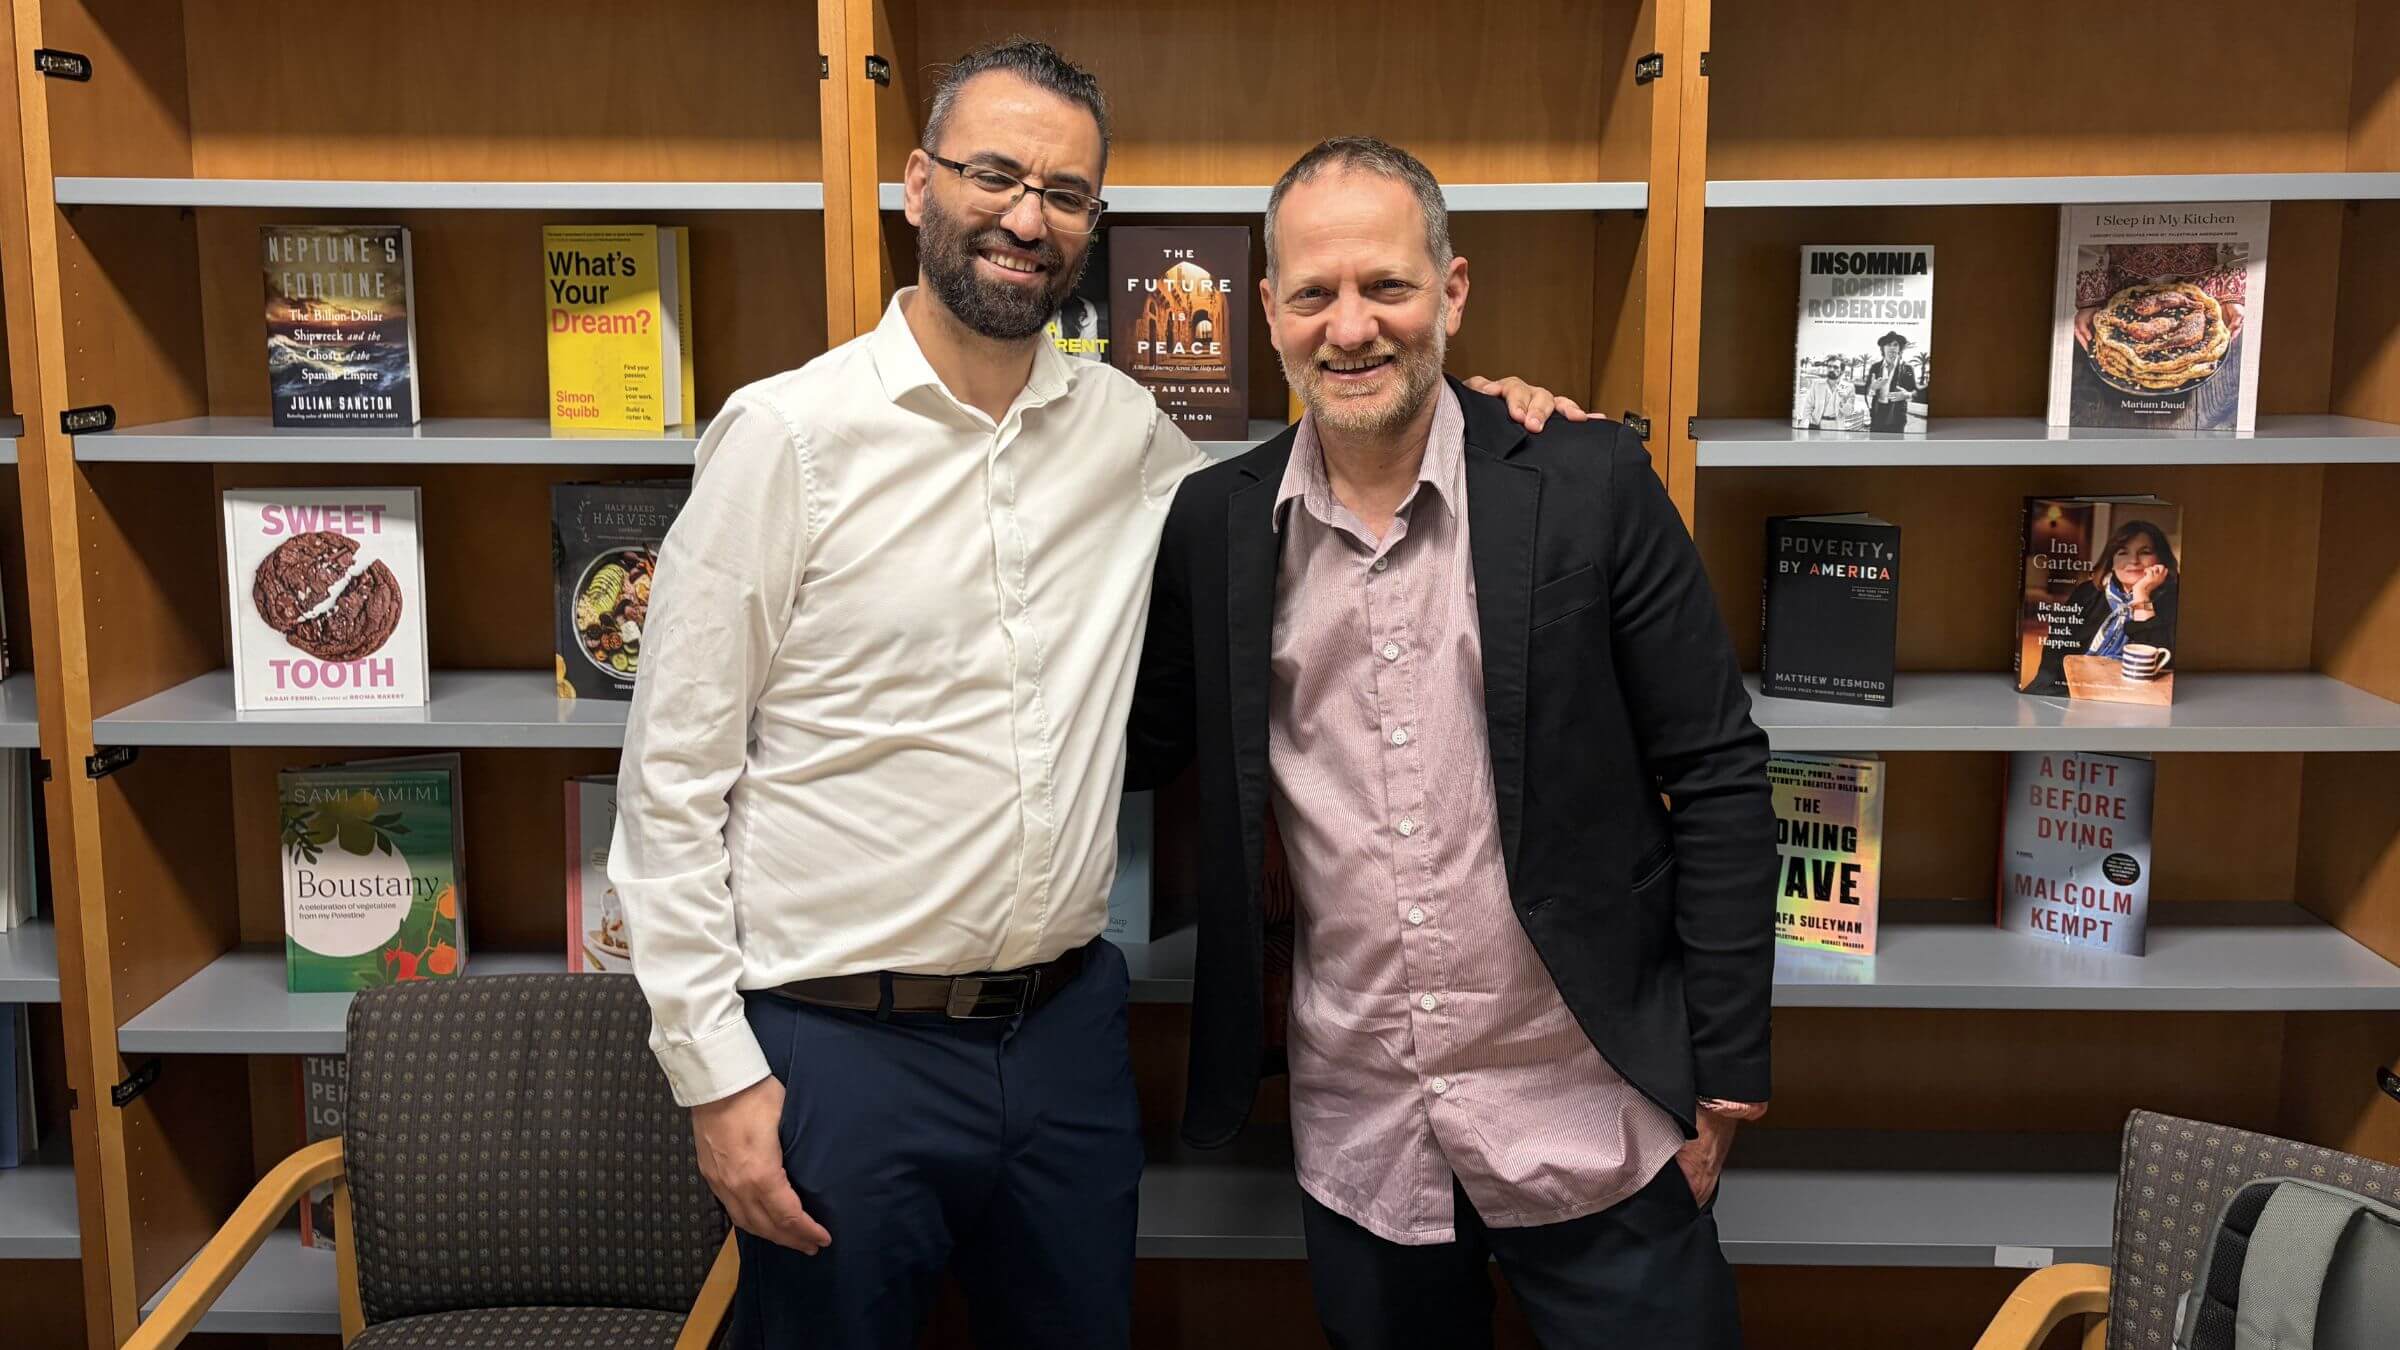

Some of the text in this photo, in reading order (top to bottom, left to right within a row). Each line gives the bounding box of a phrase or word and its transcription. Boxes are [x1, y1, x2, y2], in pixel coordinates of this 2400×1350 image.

[2096, 213, 2235, 227] I Sleep in My Kitchen
[268, 236, 396, 263] NEPTUNE'S
[1163, 249, 1194, 258] THE
[548, 251, 637, 276] What's
[1810, 252, 1927, 275] INSOMNIA
[283, 272, 385, 298] FORTUNE
[550, 279, 609, 304] Your
[1127, 278, 1232, 293] FUTURE
[1832, 277, 1904, 297] ROBBIE
[288, 308, 383, 321] The Billion-Dollar
[1172, 312, 1186, 321] IS
[1808, 299, 1927, 319] ROBERTSON
[551, 308, 651, 334] Dream?
[294, 328, 381, 345] Shipwreck and the
[1055, 338, 1109, 353] RENT
[1137, 341, 1221, 355] PEACE
[306, 349, 370, 362] Ghosts of the
[301, 367, 378, 384] Spanish Empire
[556, 390, 595, 403] Simon
[1162, 385, 1185, 393] ABU
[290, 396, 392, 411] JULIAN SANCTON
[2121, 400, 2185, 409] Mariam Daud
[556, 405, 600, 420] Squibb
[604, 503, 655, 512] HALF BAKED
[261, 504, 386, 535] SWEET
[593, 512, 667, 527] HARVEST
[1780, 536, 1894, 560] POVERTY,
[2051, 538, 2078, 554] Ina
[1779, 560, 1890, 580] BY AMERICA
[2033, 554, 2094, 572] Garten
[2038, 601, 2084, 615] Be Ready
[2037, 612, 2085, 624] When the
[2048, 625, 2072, 636] Luck
[2038, 636, 2081, 649] Happens
[269, 658, 394, 689] TOOTH
[1775, 672, 1885, 690] MATTHEW DESMOND
[2040, 756, 2119, 787] A GIFT
[294, 785, 439, 803] SAMI TAMIMI
[2031, 784, 2127, 820] BEFORE
[1794, 797, 1820, 814] THE
[1776, 818, 1857, 853] OMING
[2037, 816, 2113, 850] DYING
[298, 869, 439, 901] Boustany
[1777, 854, 1861, 905] AVE
[2015, 873, 2133, 915] MALCOLM
[299, 911, 366, 920] from my Palestine
[304, 902, 347, 911] celebration
[348, 902, 356, 910] of
[356, 902, 397, 912] vegetables
[1776, 912, 1862, 934] AFA SULEYMAN
[2030, 907, 2113, 943] KEMPT
[307, 1056, 346, 1078] THE
